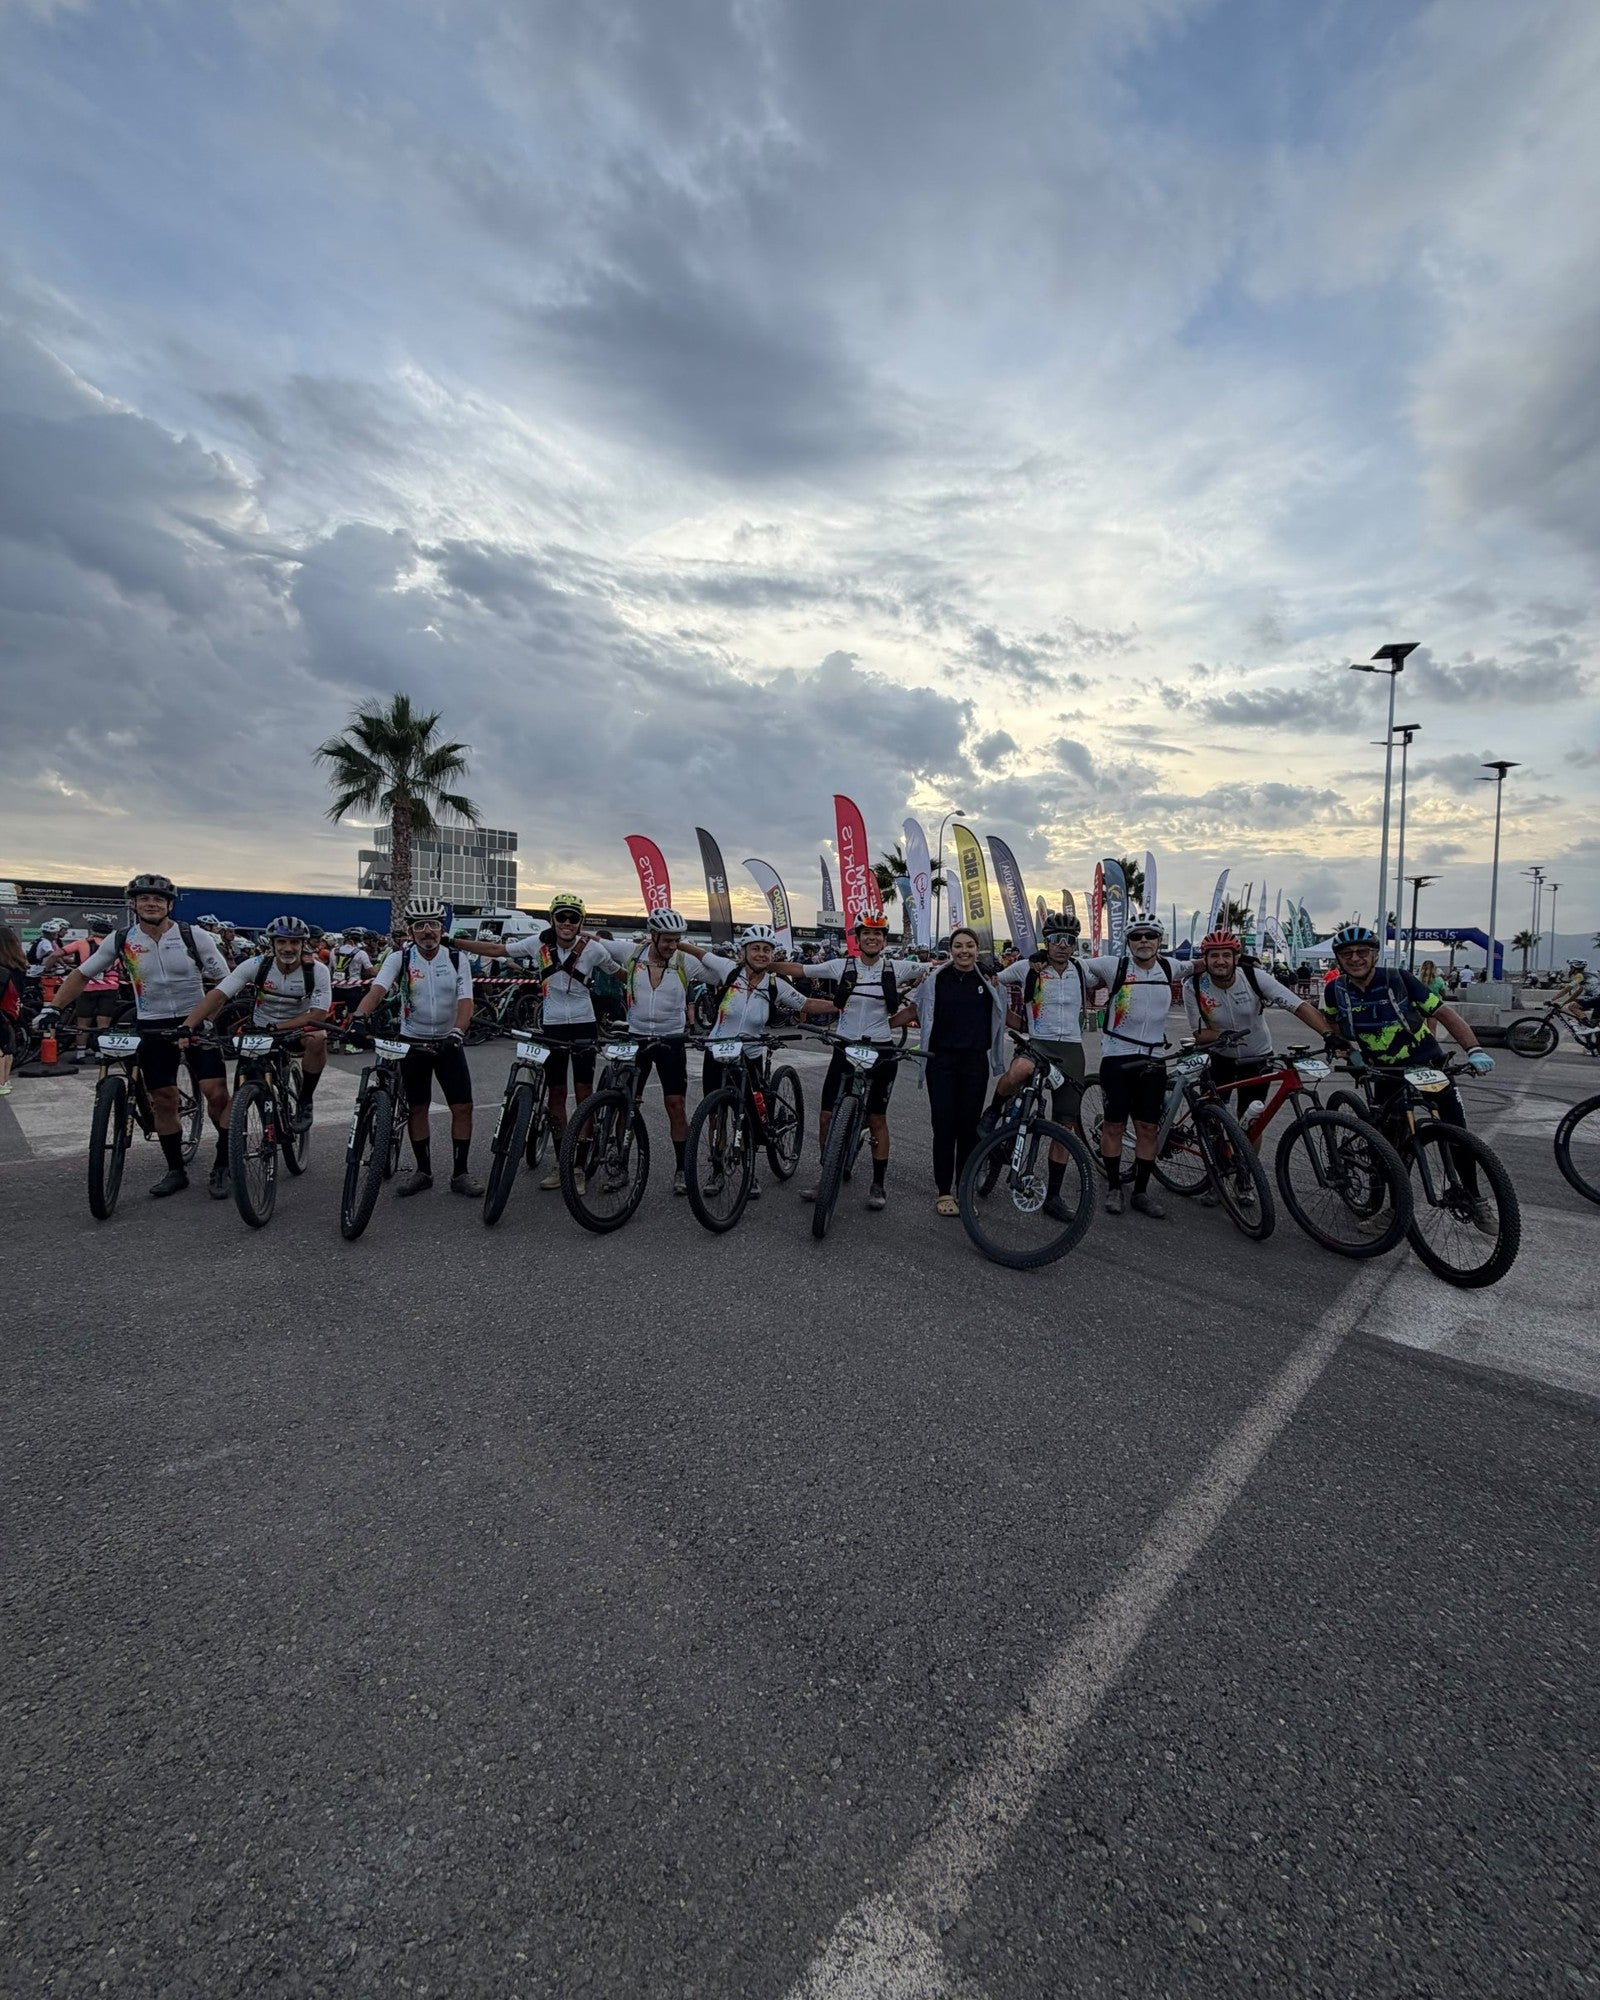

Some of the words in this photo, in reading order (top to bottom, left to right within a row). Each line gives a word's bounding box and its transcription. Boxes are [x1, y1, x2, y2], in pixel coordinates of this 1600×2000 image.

[108, 1037, 129, 1045] 374
[526, 1046, 541, 1055] 110
[1413, 1070, 1437, 1080] 394
